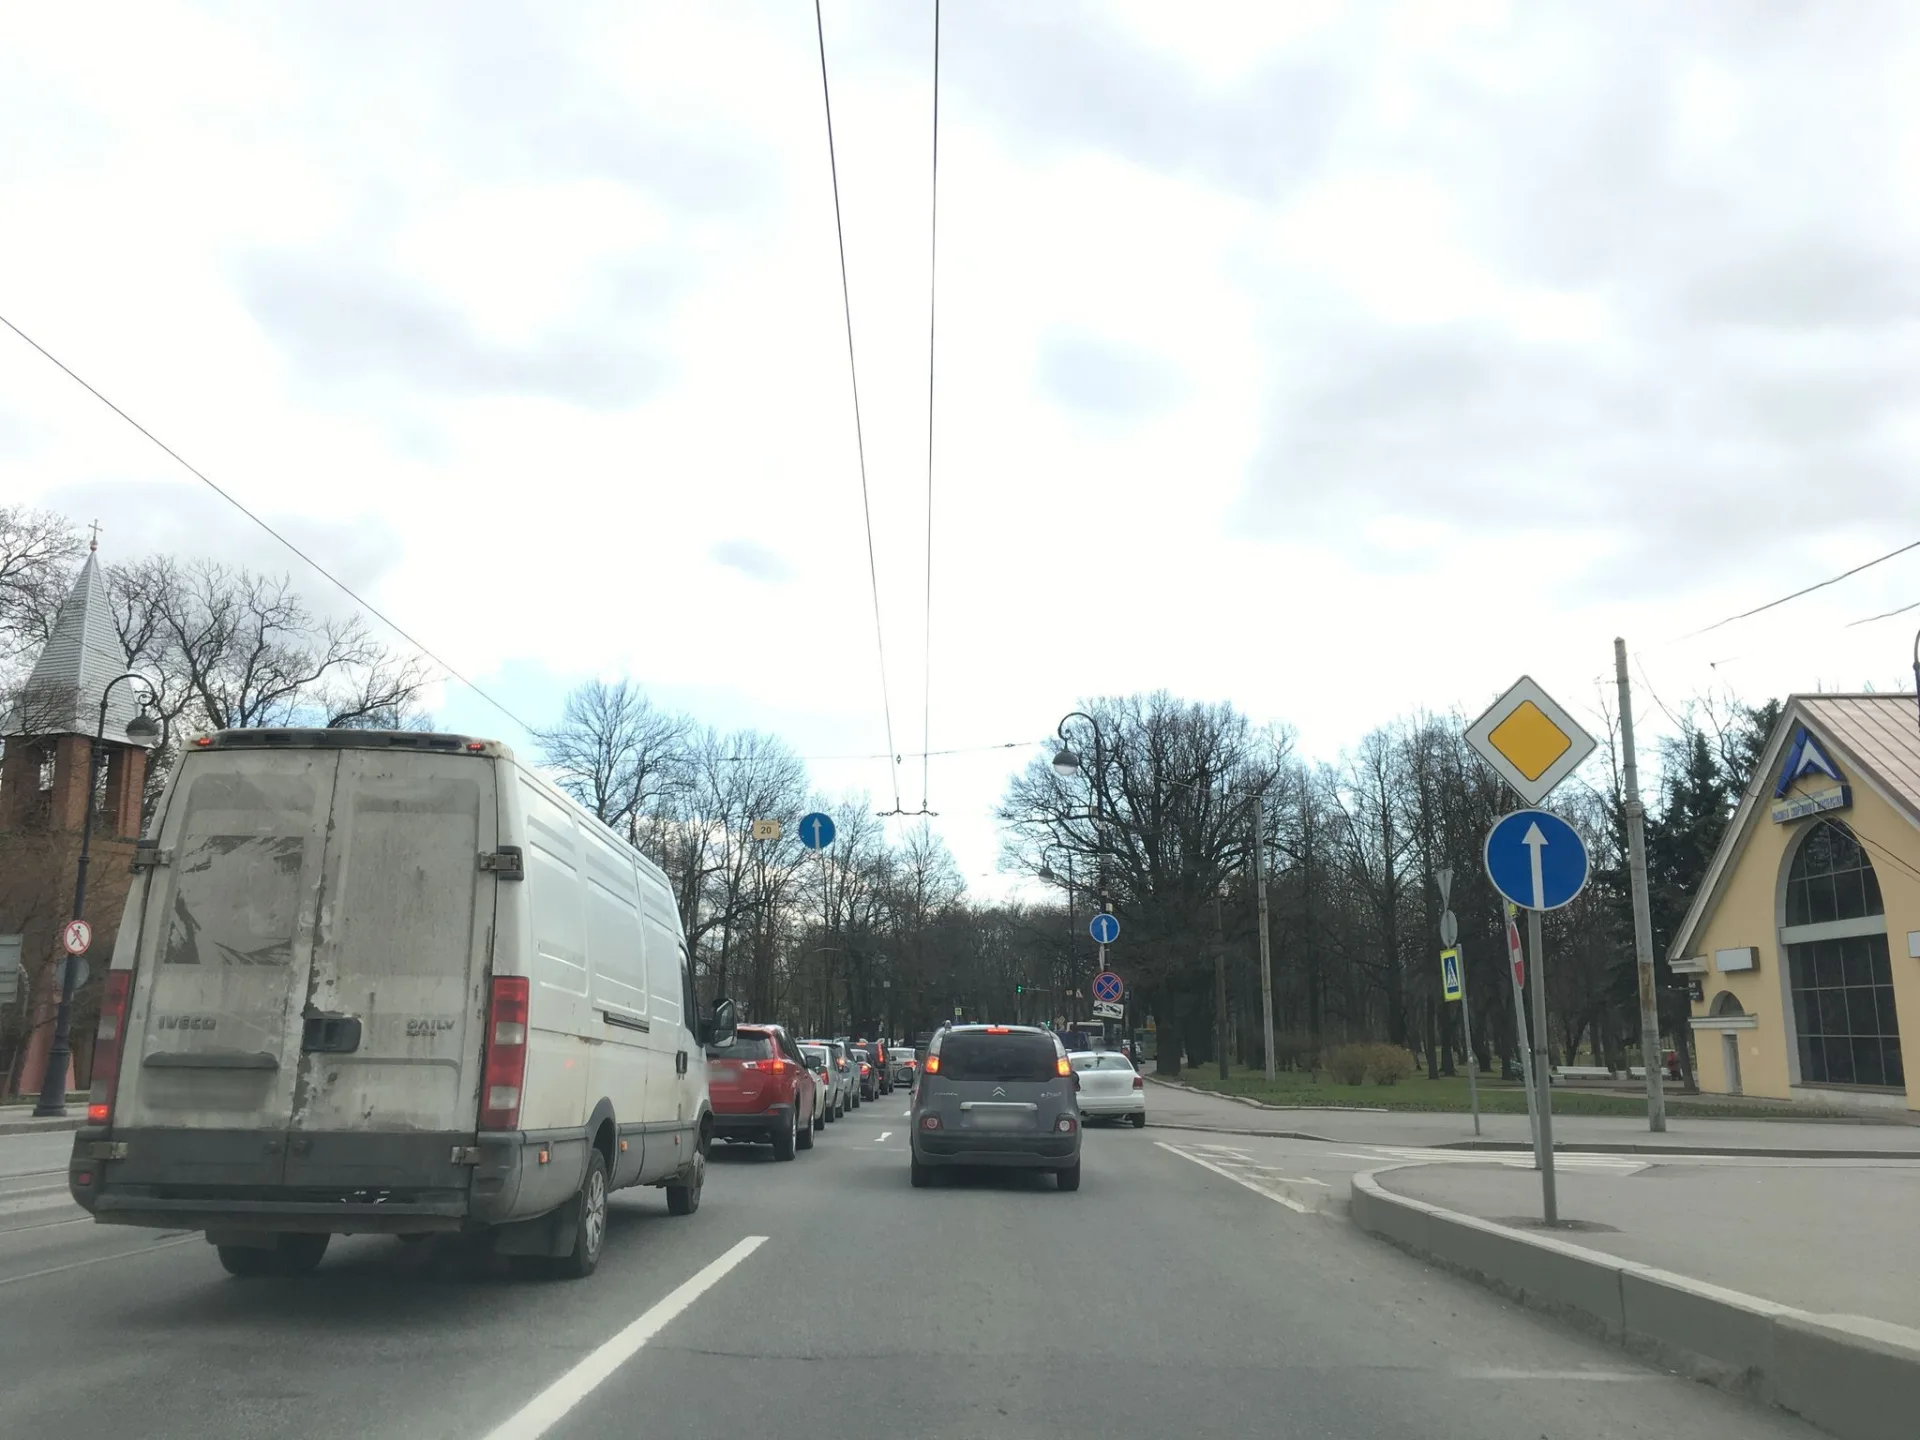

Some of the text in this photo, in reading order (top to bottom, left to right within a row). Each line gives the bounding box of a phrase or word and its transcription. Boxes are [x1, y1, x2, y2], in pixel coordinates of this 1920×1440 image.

[760, 826, 772, 835] 20
[158, 1015, 217, 1030] IVECO
[406, 1019, 456, 1030] DAILY
